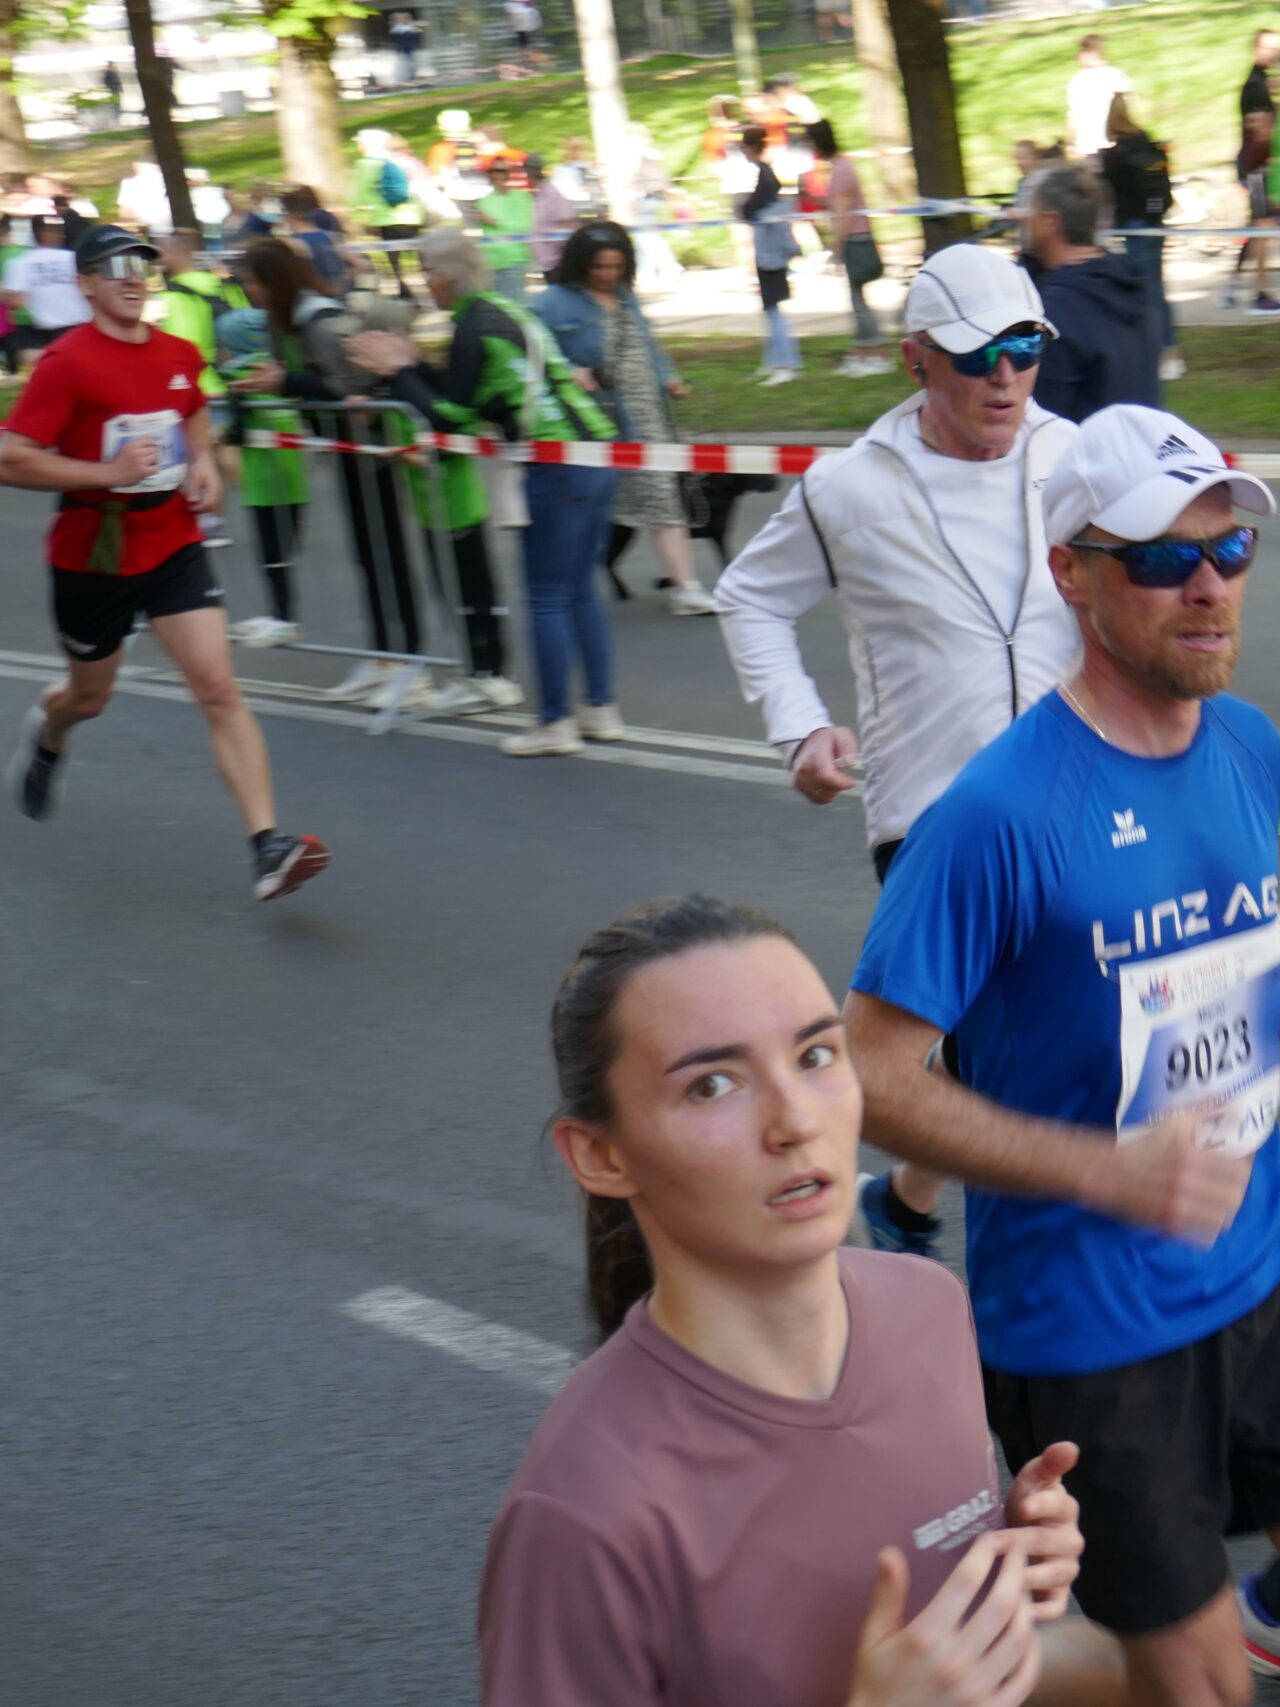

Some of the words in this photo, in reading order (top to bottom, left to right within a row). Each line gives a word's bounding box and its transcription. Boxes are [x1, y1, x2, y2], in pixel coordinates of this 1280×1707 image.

[1093, 889, 1210, 961] LINZ
[1223, 873, 1279, 927] AG
[1165, 1014, 1252, 1092] 9023
